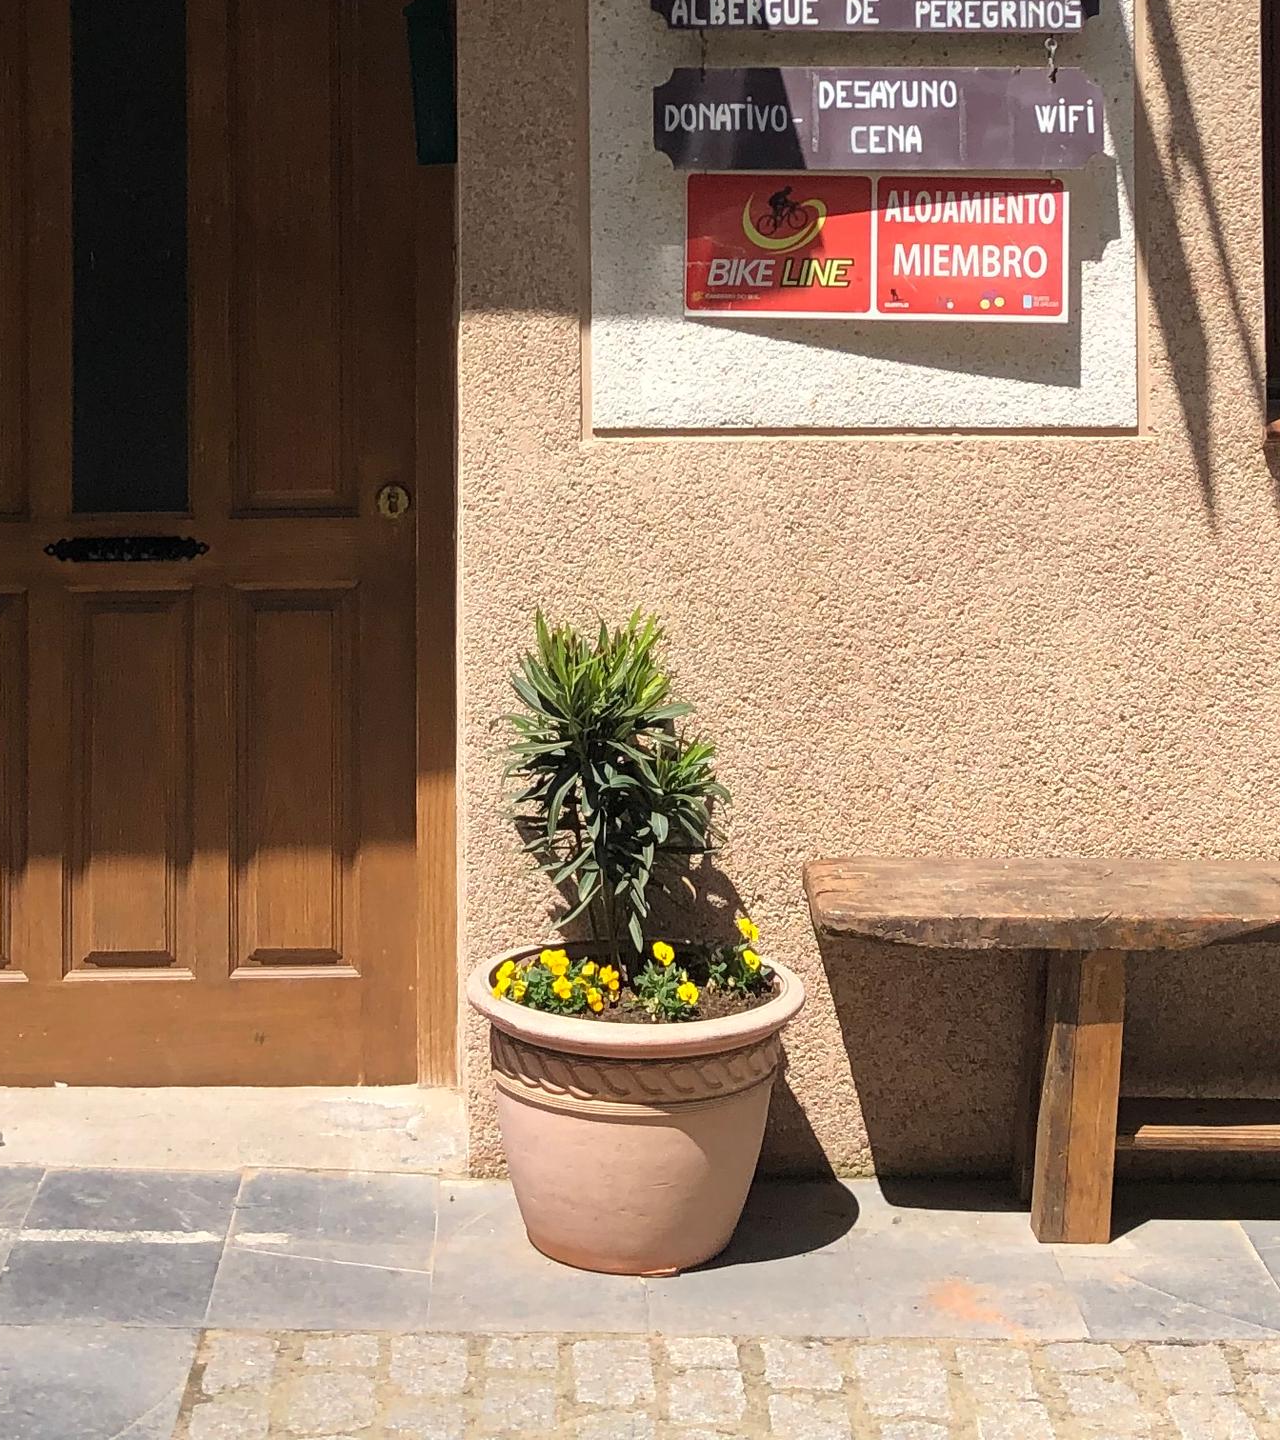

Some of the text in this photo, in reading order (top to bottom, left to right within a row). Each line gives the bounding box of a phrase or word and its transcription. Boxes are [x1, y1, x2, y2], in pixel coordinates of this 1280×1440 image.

[819, 79, 958, 109] DESAYUNO
[850, 125, 923, 155] CENA
[884, 189, 1056, 225] ALOJAMIENTO
[707, 257, 855, 288] BIKE LINE
[893, 243, 1048, 279] MIEMBRO
